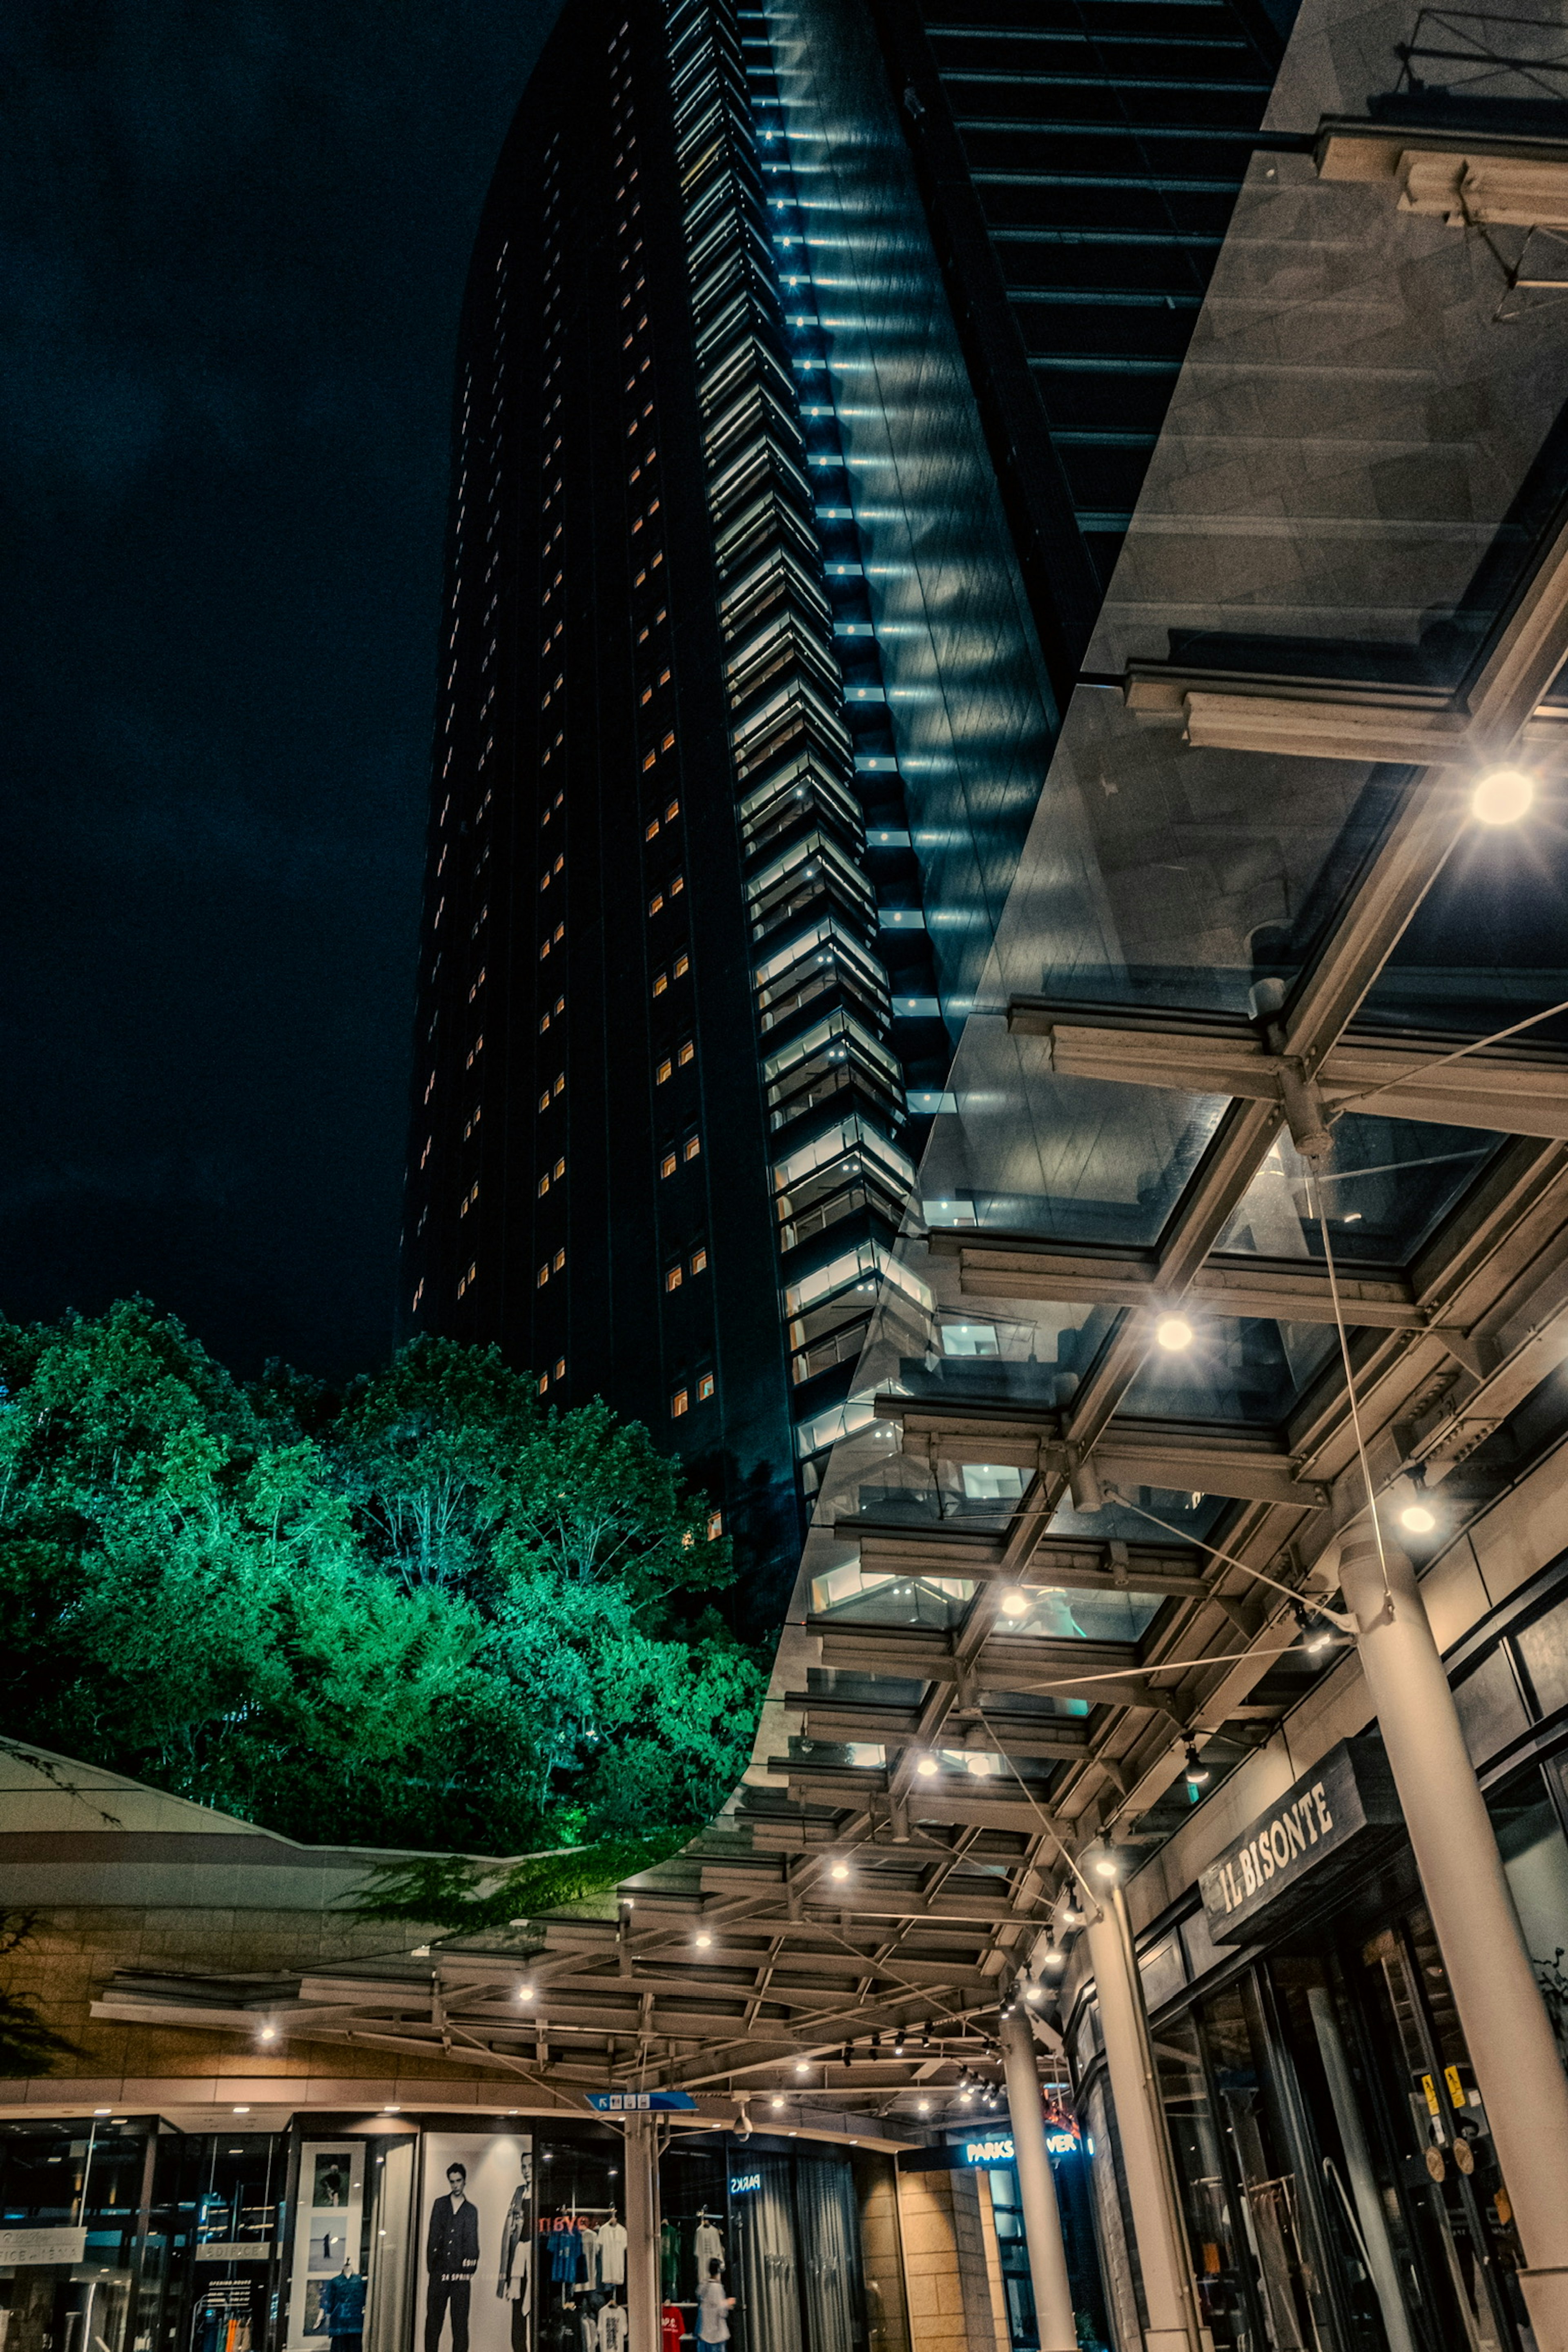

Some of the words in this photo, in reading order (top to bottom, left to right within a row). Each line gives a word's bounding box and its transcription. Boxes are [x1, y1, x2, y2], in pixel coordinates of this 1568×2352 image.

[1219, 1862, 1243, 1914] IL
[1238, 1782, 1333, 1898] BISONTE
[967, 2140, 1014, 2163] PARKS
[1046, 2134, 1077, 2153] VER
